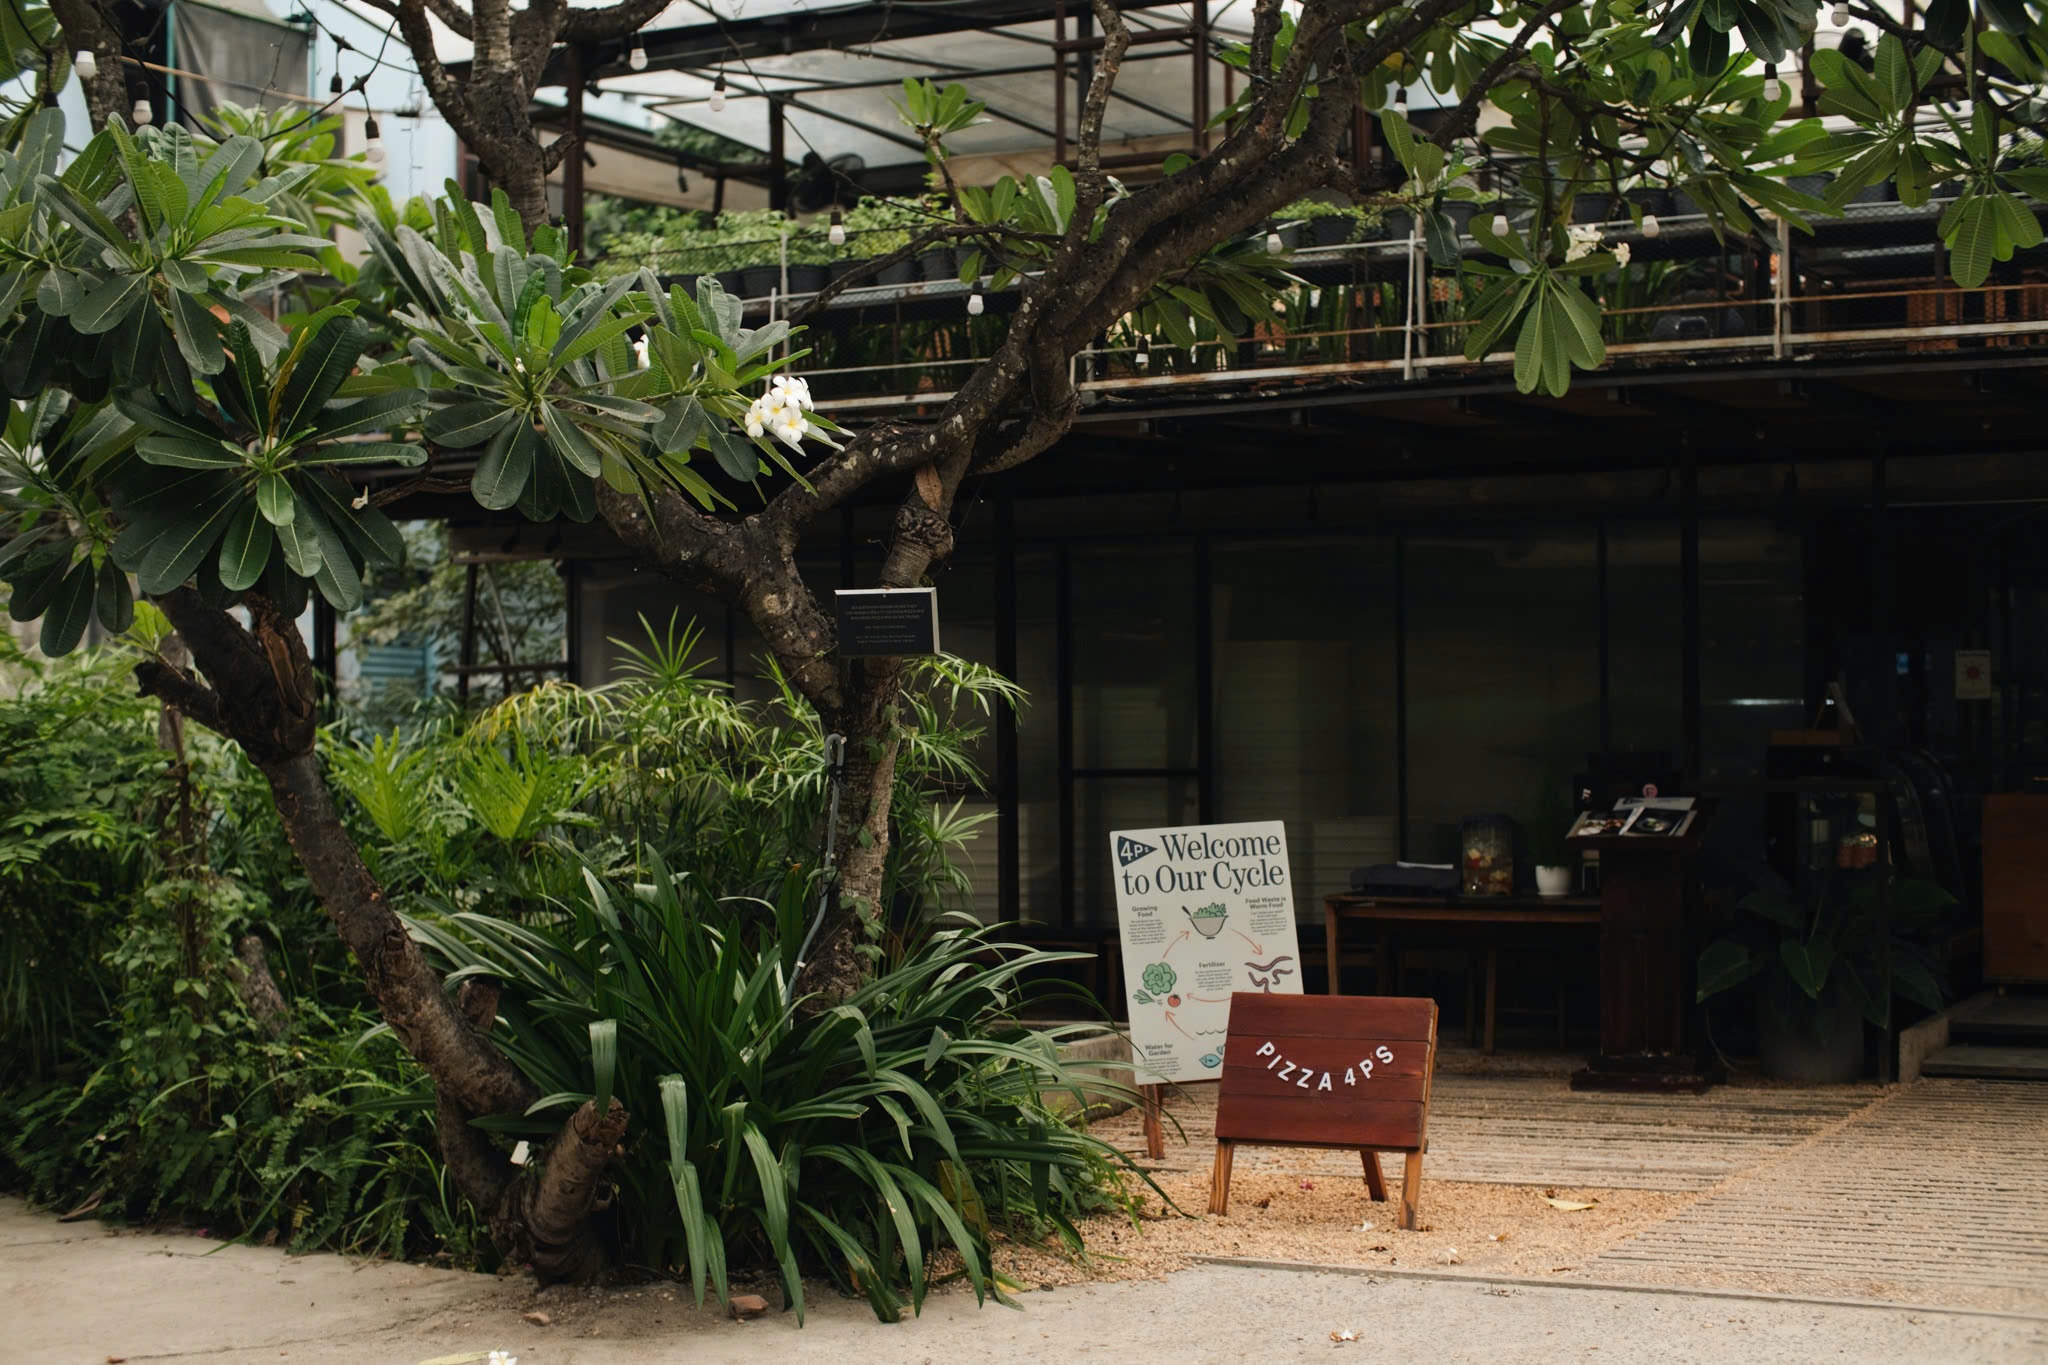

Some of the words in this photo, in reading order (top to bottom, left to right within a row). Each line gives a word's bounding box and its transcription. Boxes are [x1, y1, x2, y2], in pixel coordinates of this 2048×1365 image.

[1160, 832, 1281, 862] Welcome
[1122, 869, 1150, 896] to
[1155, 865, 1207, 893] Our
[1212, 859, 1285, 895] Cycle
[1255, 1041, 1333, 1092] PIZZA
